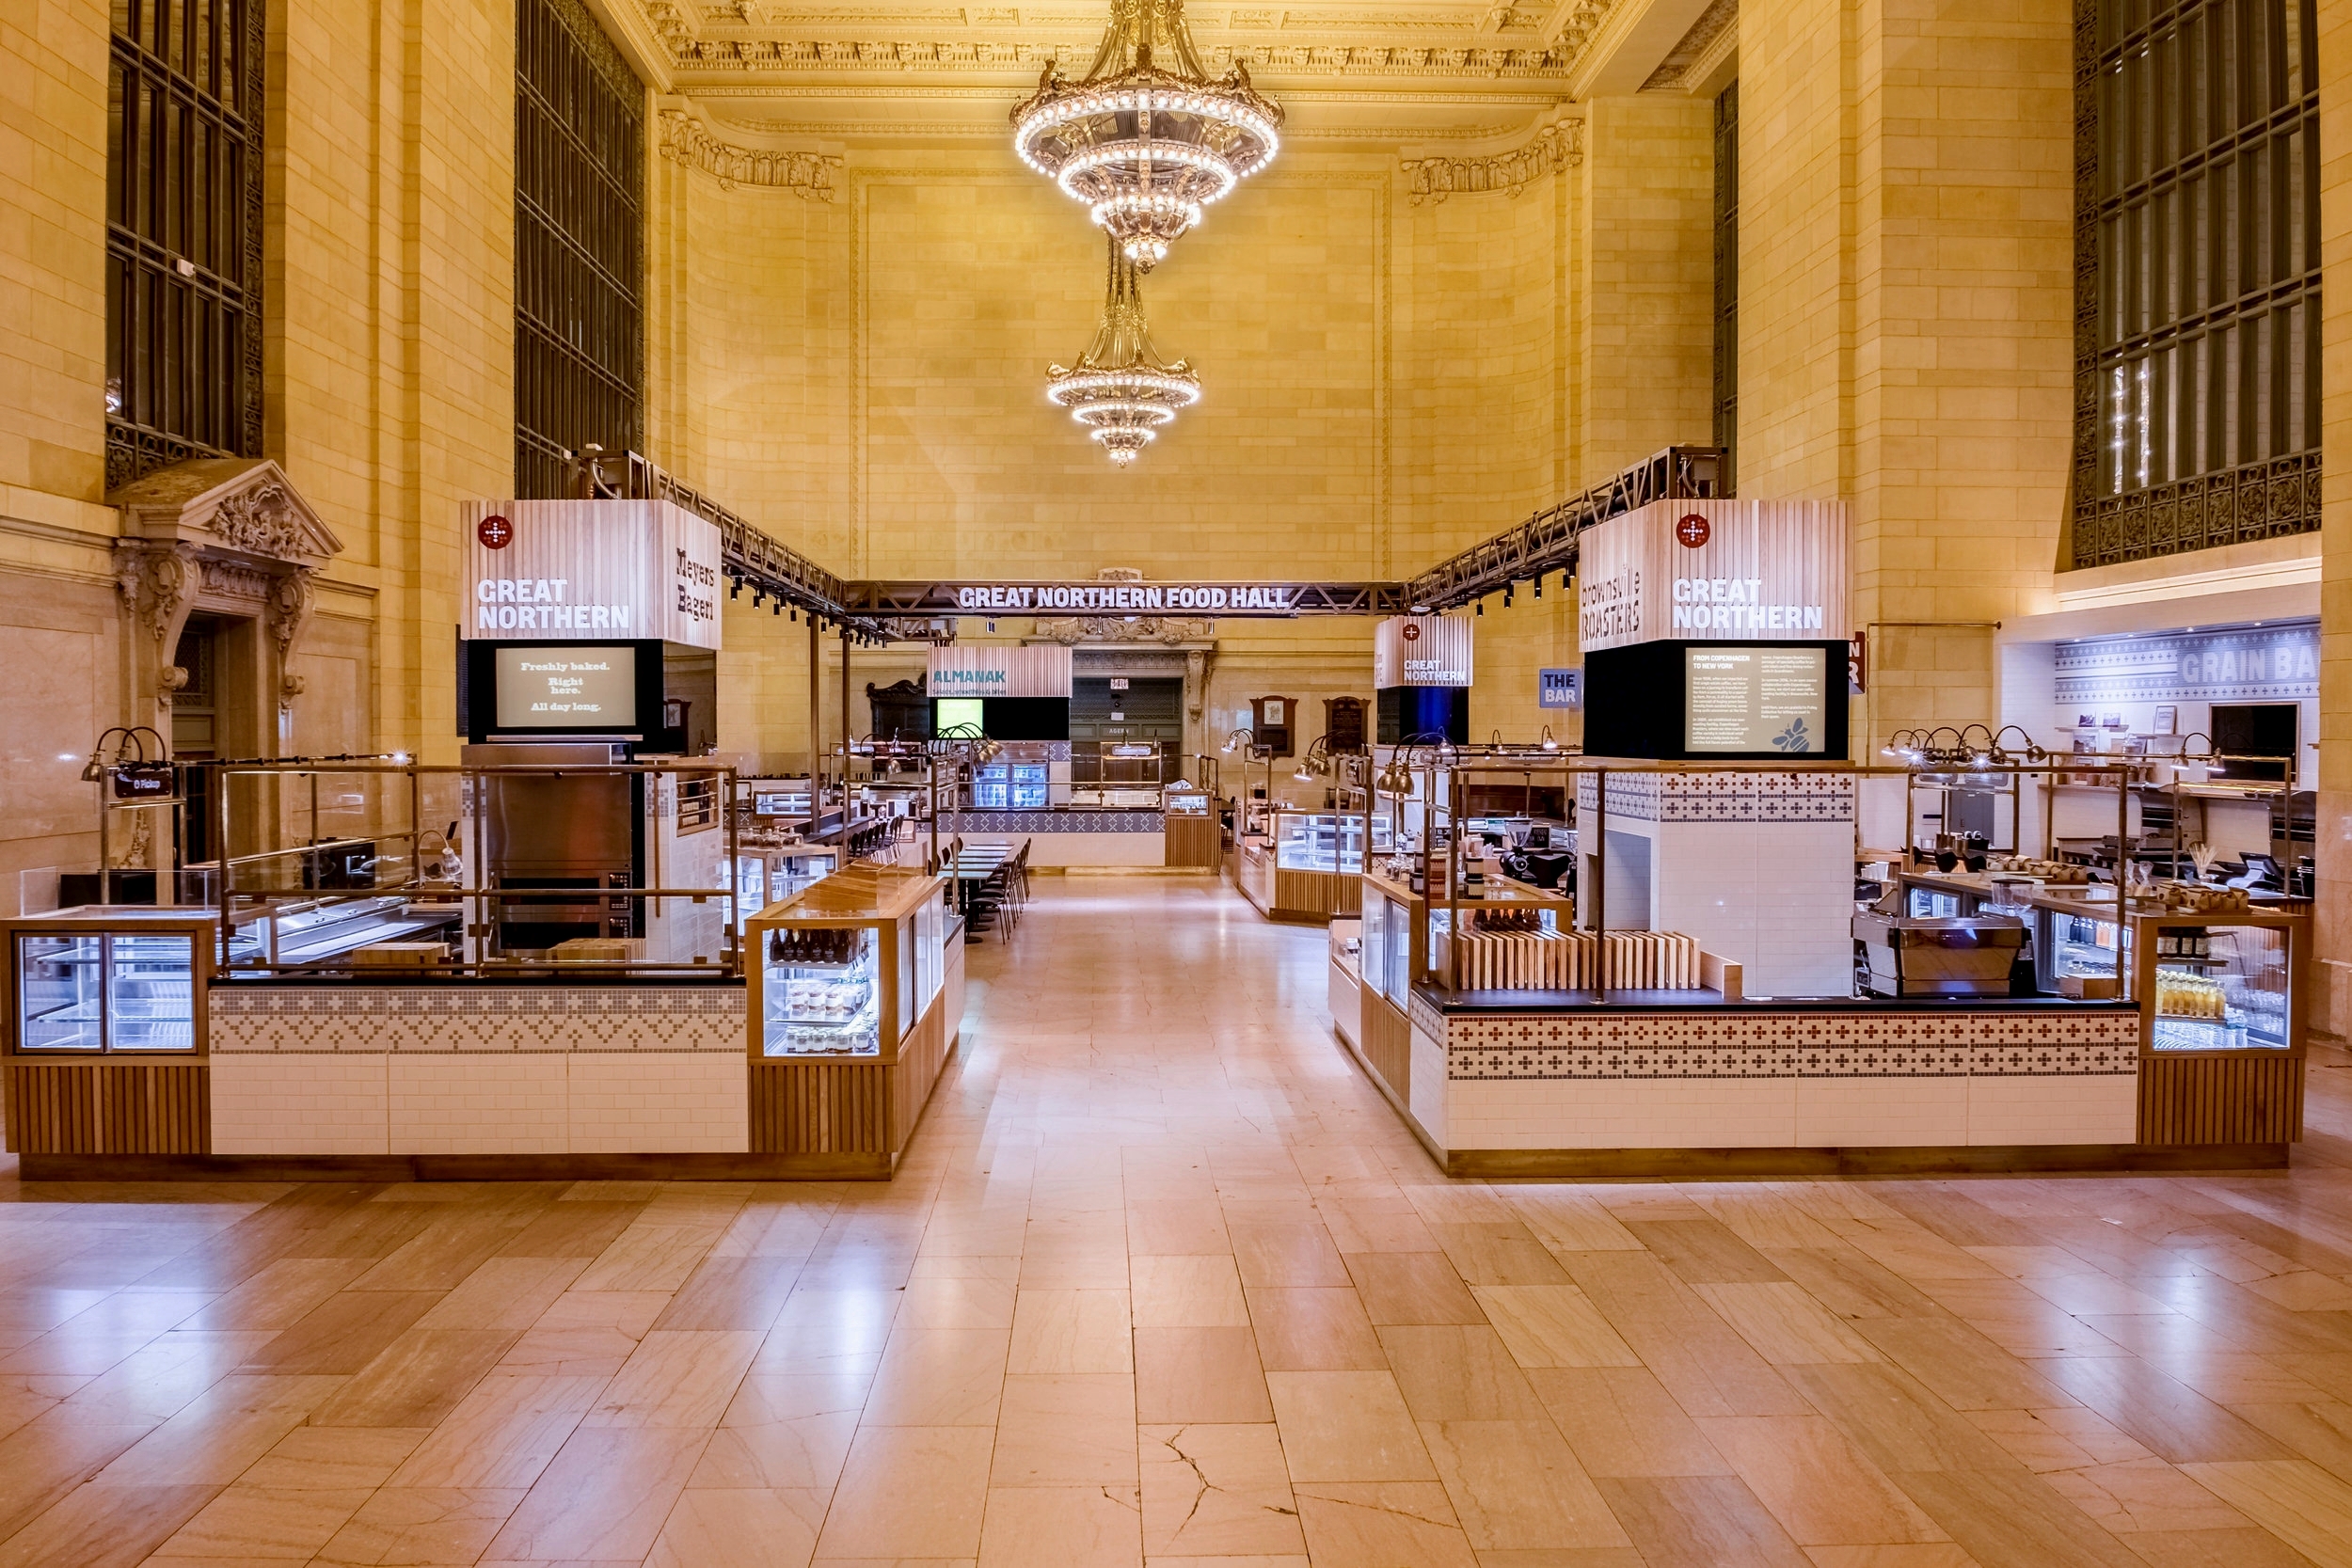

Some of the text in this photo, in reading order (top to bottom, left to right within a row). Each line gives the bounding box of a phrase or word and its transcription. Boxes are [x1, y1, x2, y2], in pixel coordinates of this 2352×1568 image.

[676, 547, 714, 587] Meyers
[478, 579, 568, 603] GREAT
[1581, 564, 1640, 608] brownsville
[1673, 579, 1761, 603] GREAT
[677, 584, 713, 622] Bageri
[959, 587, 1290, 608] GREAT NORTHERN FOOD HALL
[478, 605, 629, 629] NORTHERN
[1581, 599, 1640, 641] ROASTERS
[1673, 605, 1822, 629] NORTHERN
[520, 662, 611, 672] Freshly baked.
[1404, 659, 1440, 671] GREAT
[2182, 644, 2316, 683] GRAIN BA
[548, 677, 583, 687] Right
[933, 670, 1006, 683] ALMANAK
[1404, 671, 1466, 681] NORTHERN
[1544, 673, 1576, 688] THE
[550, 686, 581, 694] here.
[1545, 689, 1576, 703] BAR
[530, 703, 602, 712] All day long.
